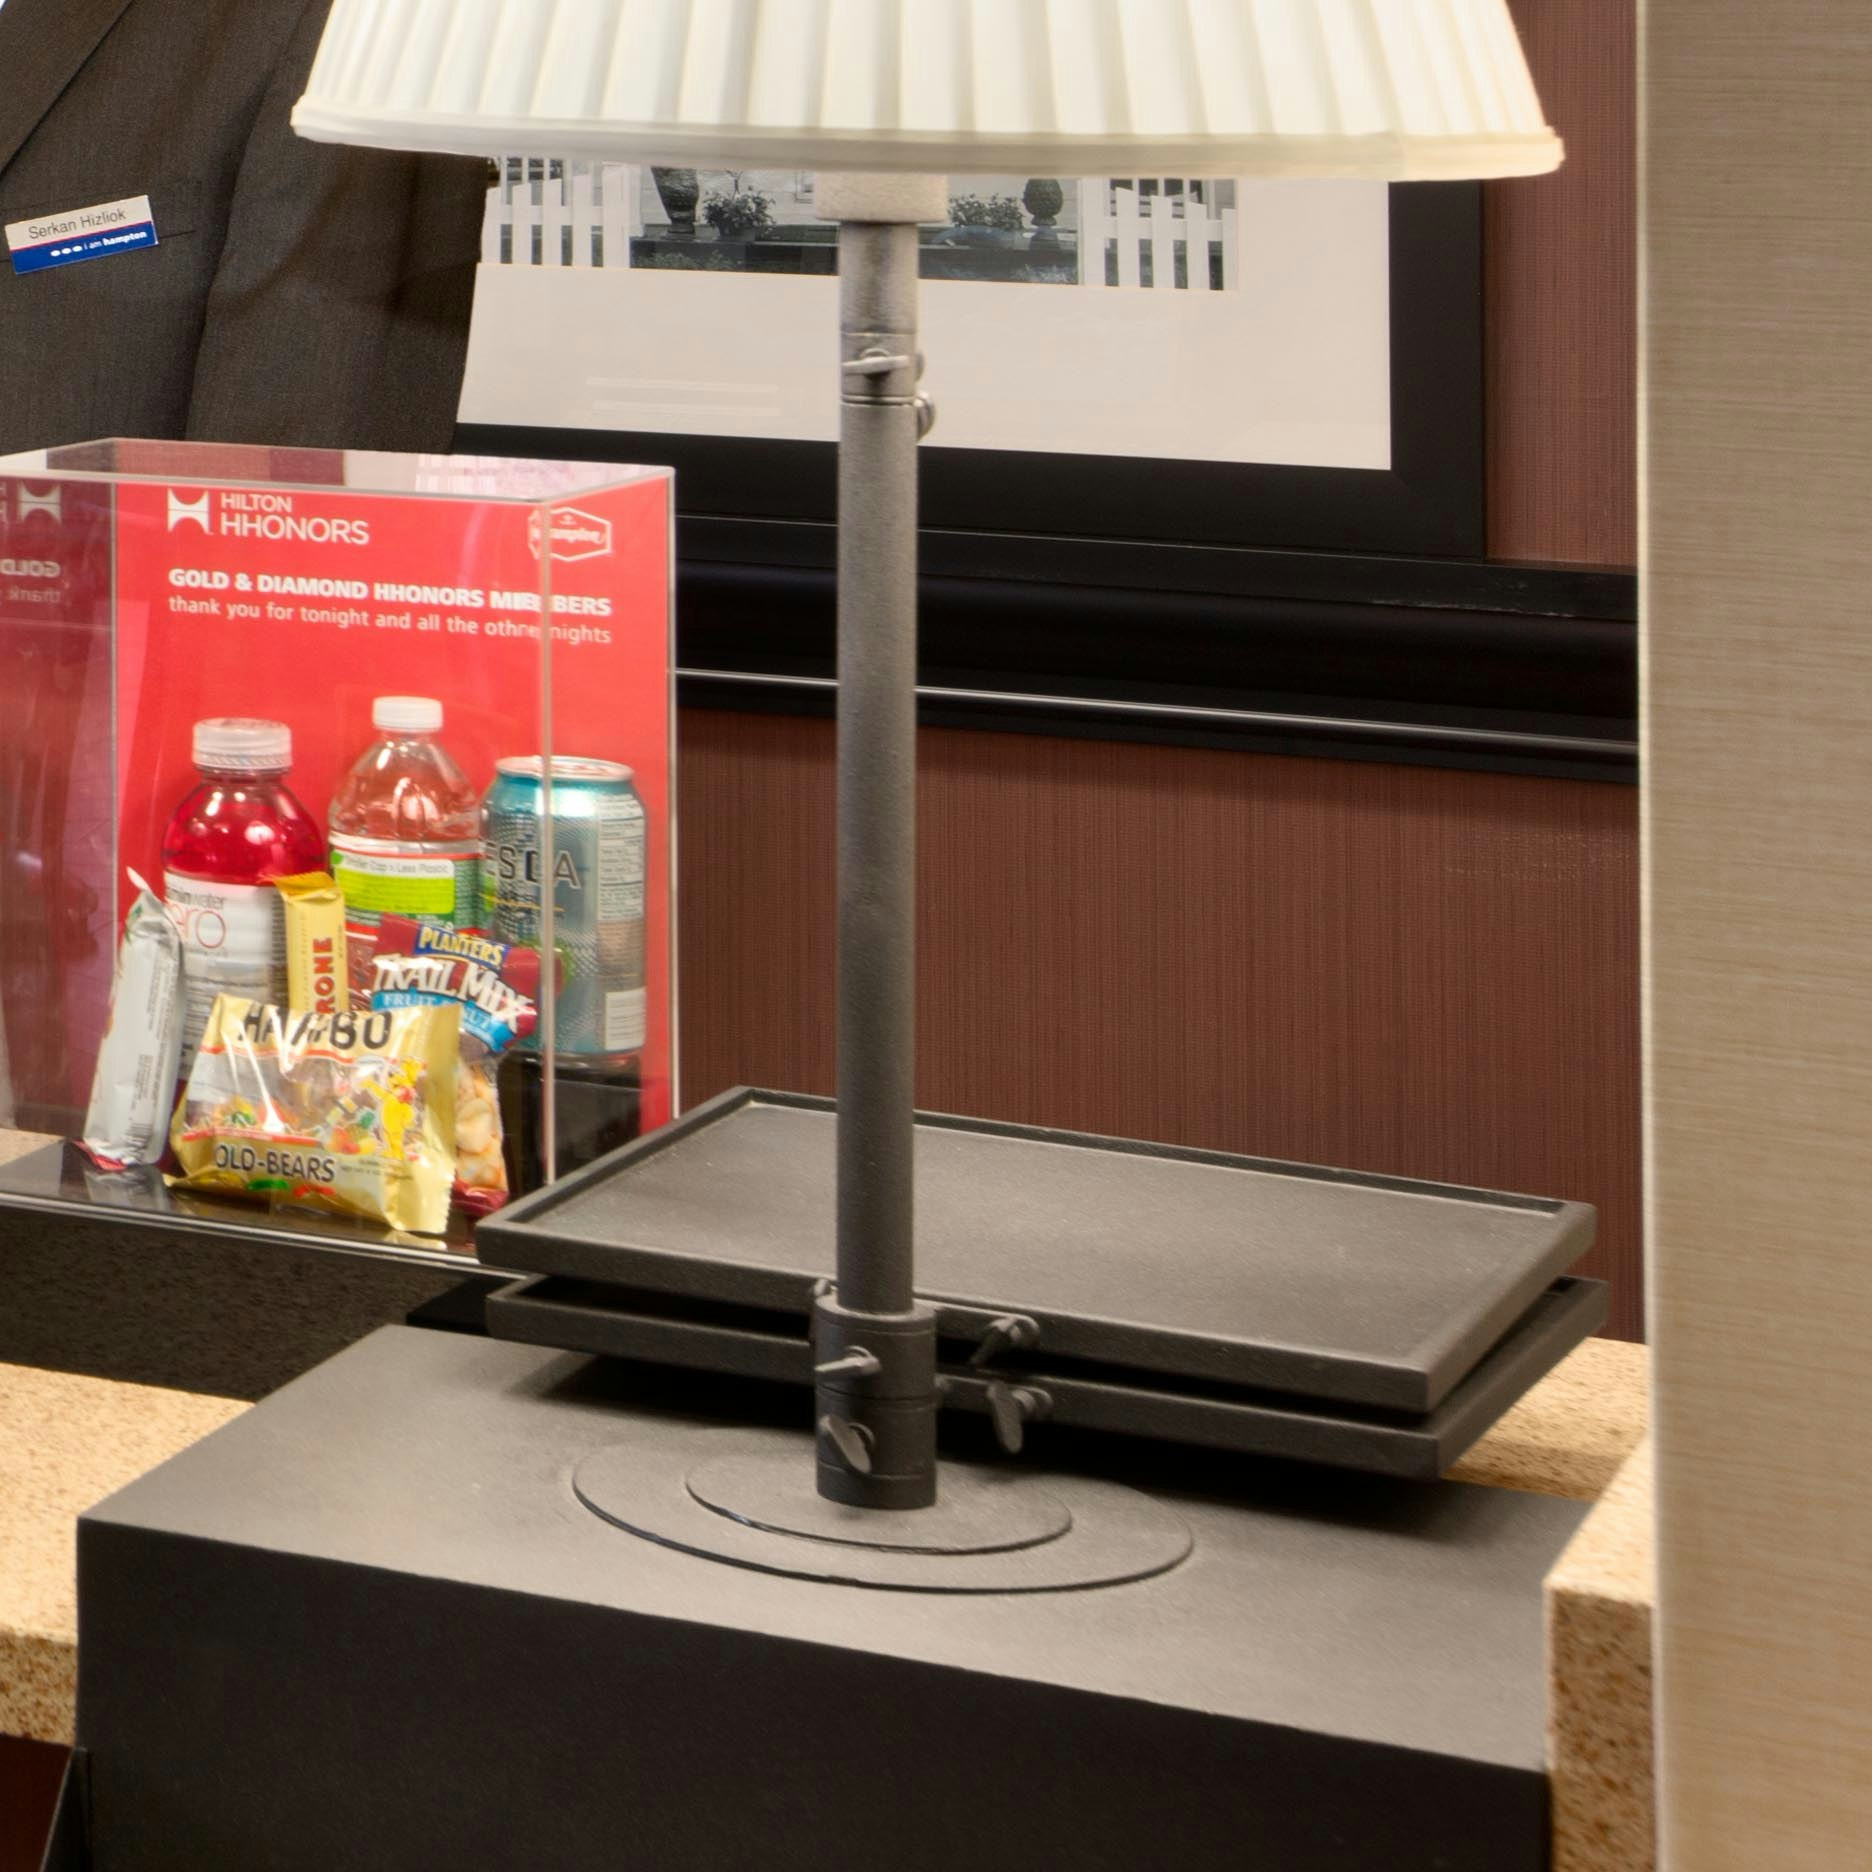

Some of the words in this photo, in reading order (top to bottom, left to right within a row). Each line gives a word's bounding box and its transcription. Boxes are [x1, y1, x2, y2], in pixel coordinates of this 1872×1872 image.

[28, 221, 77, 240] Serkan
[102, 231, 147, 246] hampton
[220, 491, 292, 513] HILTON
[220, 513, 370, 545] HHONORS
[168, 568, 229, 589] GOLD
[234, 572, 253, 592] &
[256, 574, 369, 600] DIAMOND
[374, 582, 484, 608] HHONORS
[168, 596, 221, 615] thank
[227, 601, 260, 620] you
[266, 599, 293, 619] for
[300, 606, 369, 630] tonight
[375, 611, 410, 629] and
[417, 614, 440, 632] all
[447, 616, 478, 634] the
[550, 624, 612, 645] nights
[419, 926, 504, 966] PLANTERS
[372, 953, 456, 996] TRAIL
[459, 961, 537, 1033] MIX
[215, 1144, 335, 1184] OLD-BEARS
